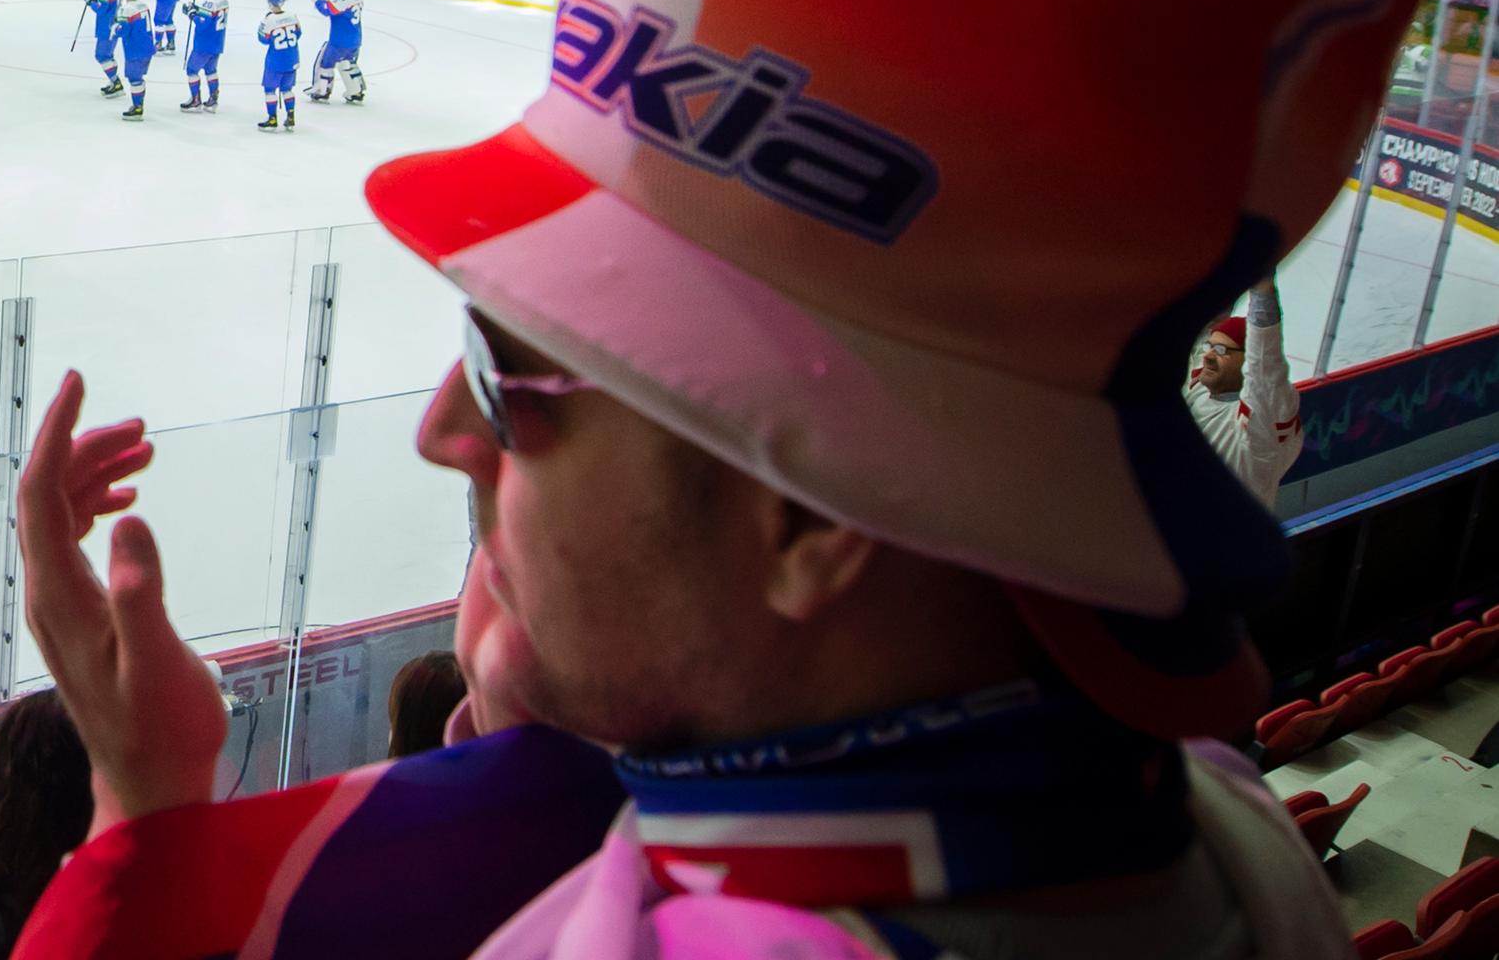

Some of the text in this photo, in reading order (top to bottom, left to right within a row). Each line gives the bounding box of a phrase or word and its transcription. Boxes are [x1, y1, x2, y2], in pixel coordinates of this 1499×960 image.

[215, 10, 228, 31] 2
[274, 26, 298, 50] 25
[219, 654, 362, 703] STEEL
